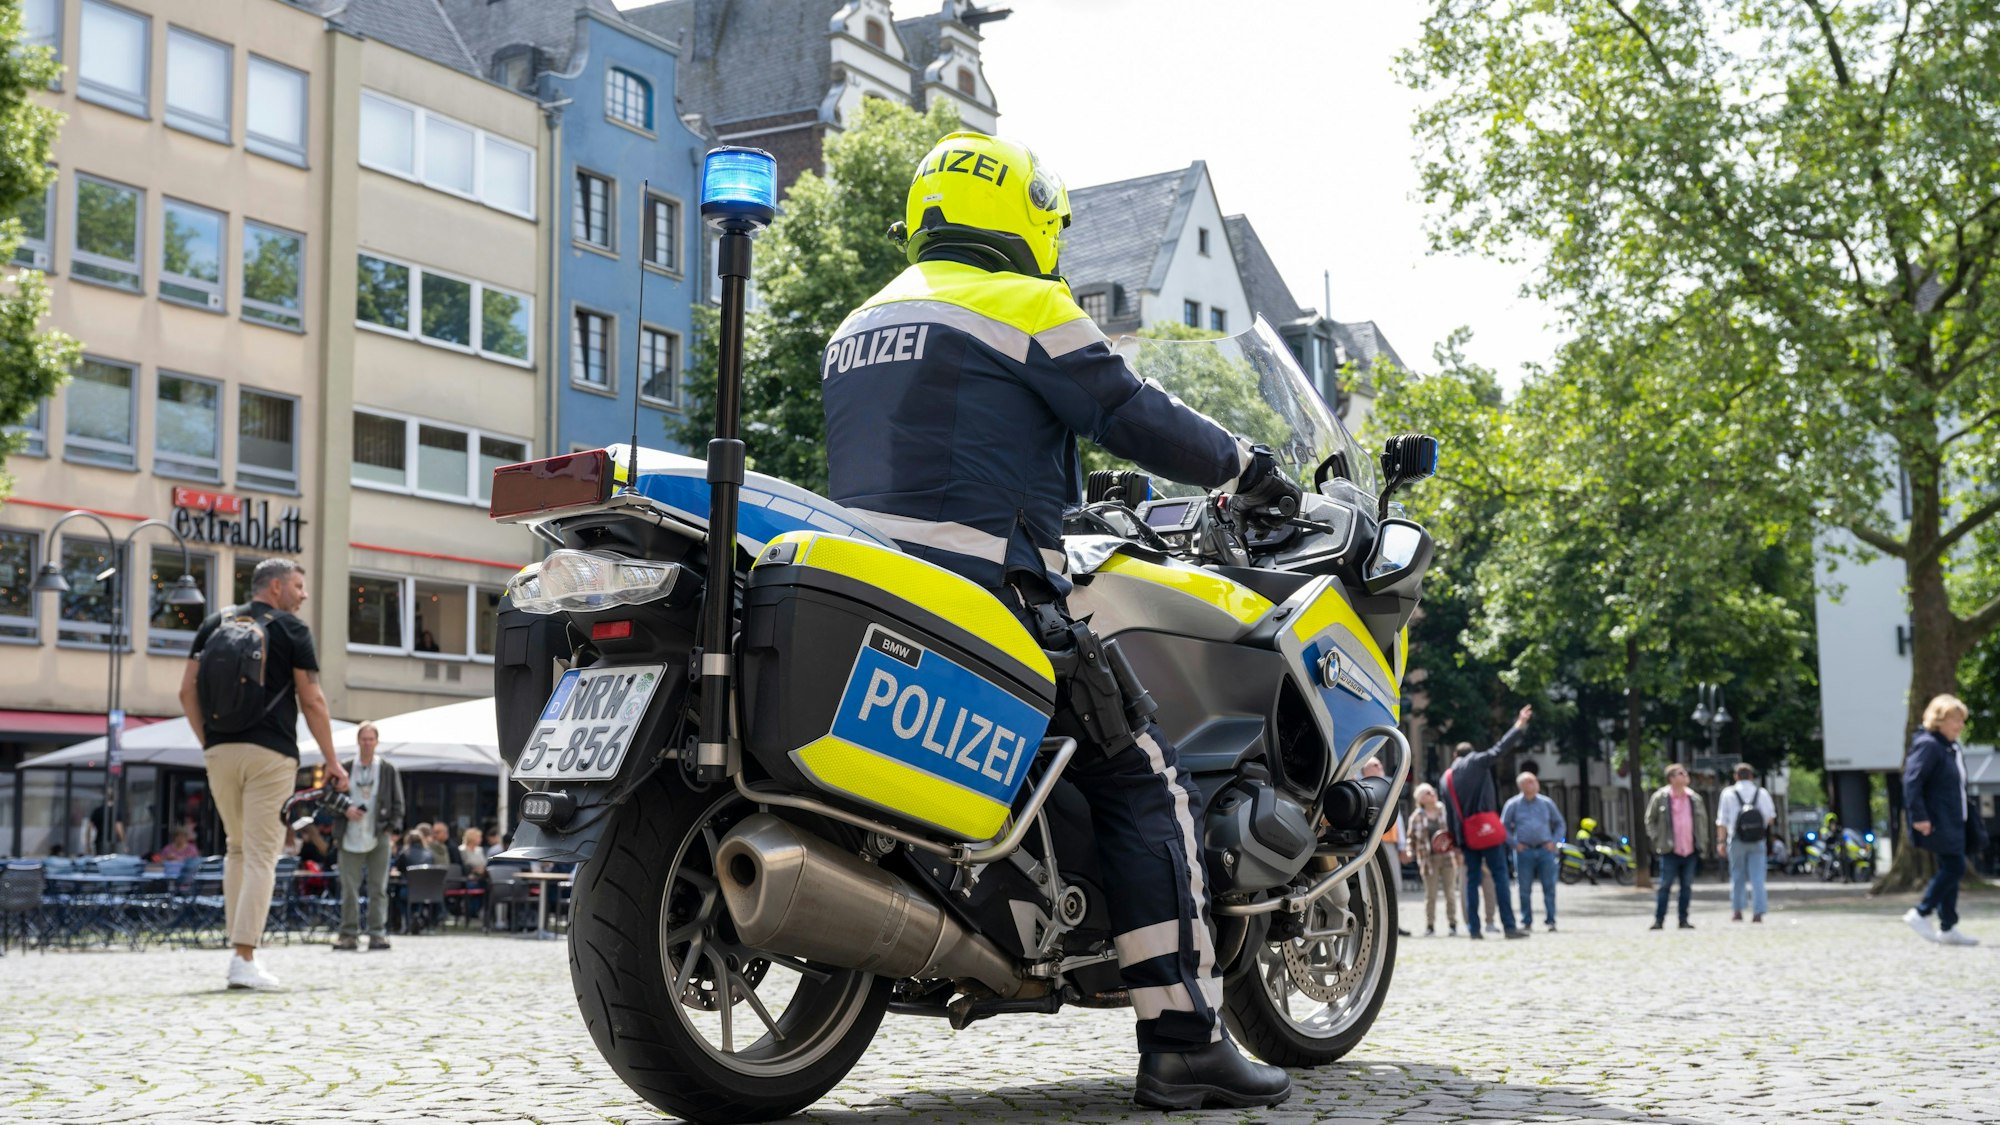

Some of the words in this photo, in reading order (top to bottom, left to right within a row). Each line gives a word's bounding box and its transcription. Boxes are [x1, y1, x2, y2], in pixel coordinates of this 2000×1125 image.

[911, 149, 1009, 187] LIZEI
[822, 324, 929, 381] POLIZEI
[169, 498, 308, 553] extrablatt
[881, 638, 910, 659] BMW
[549, 701, 560, 714] D
[558, 673, 637, 721] NRW
[520, 725, 629, 772] 5-856
[857, 667, 1026, 787] POLIZEI
